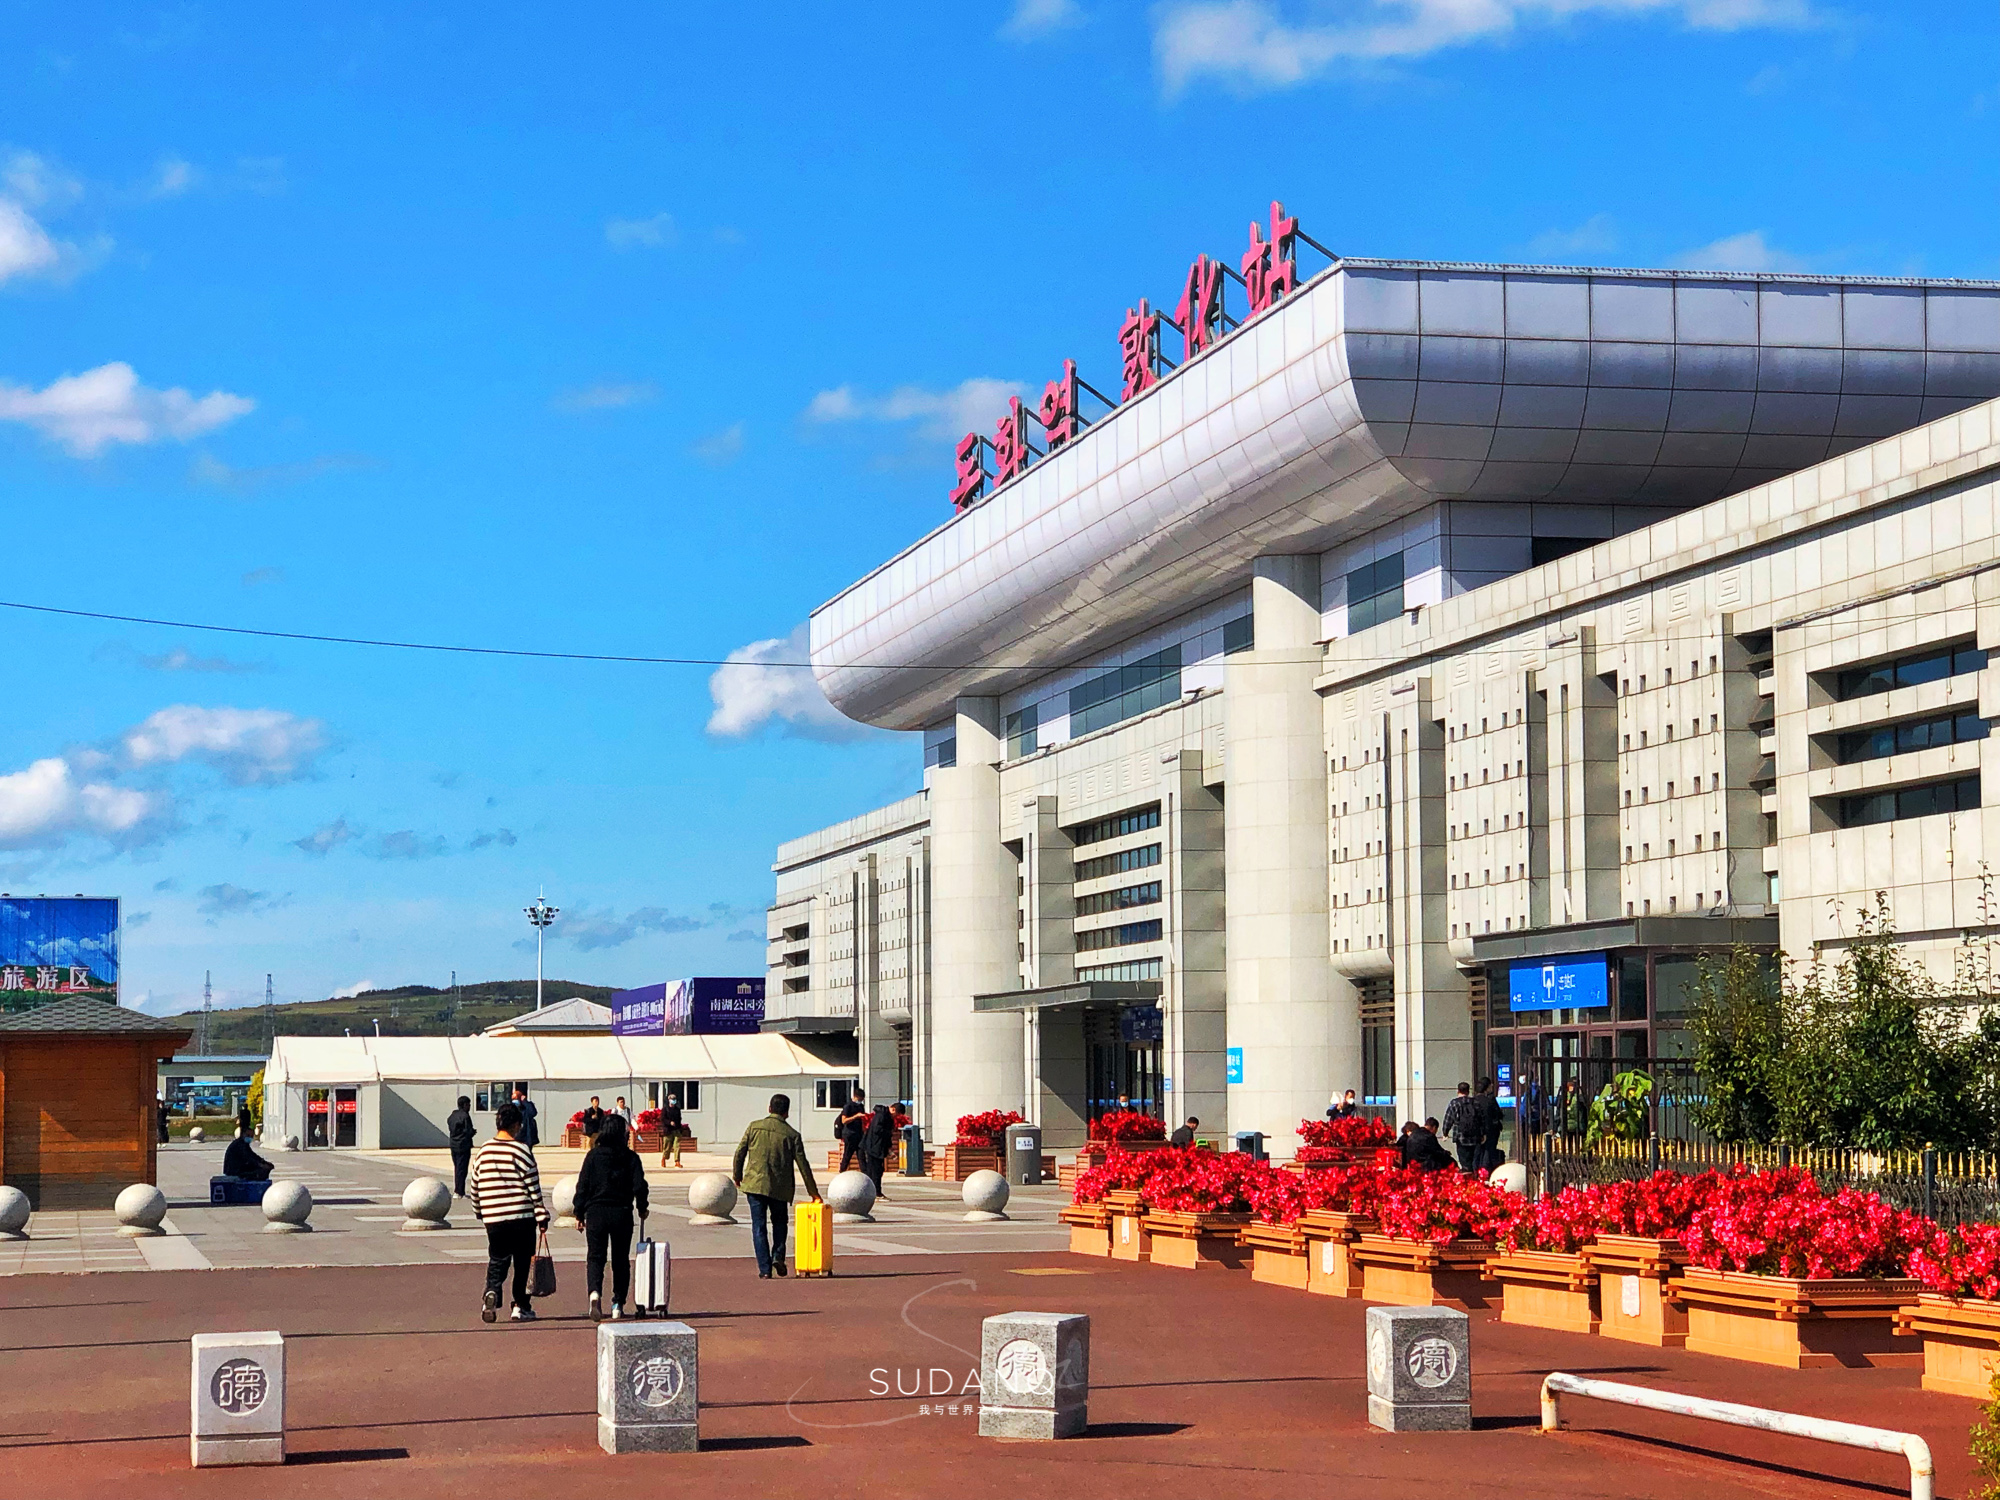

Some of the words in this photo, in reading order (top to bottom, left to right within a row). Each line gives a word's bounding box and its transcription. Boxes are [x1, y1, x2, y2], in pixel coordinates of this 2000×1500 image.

[1118, 200, 1298, 404] 敦化站
[2, 965, 91, 991] 旅游区
